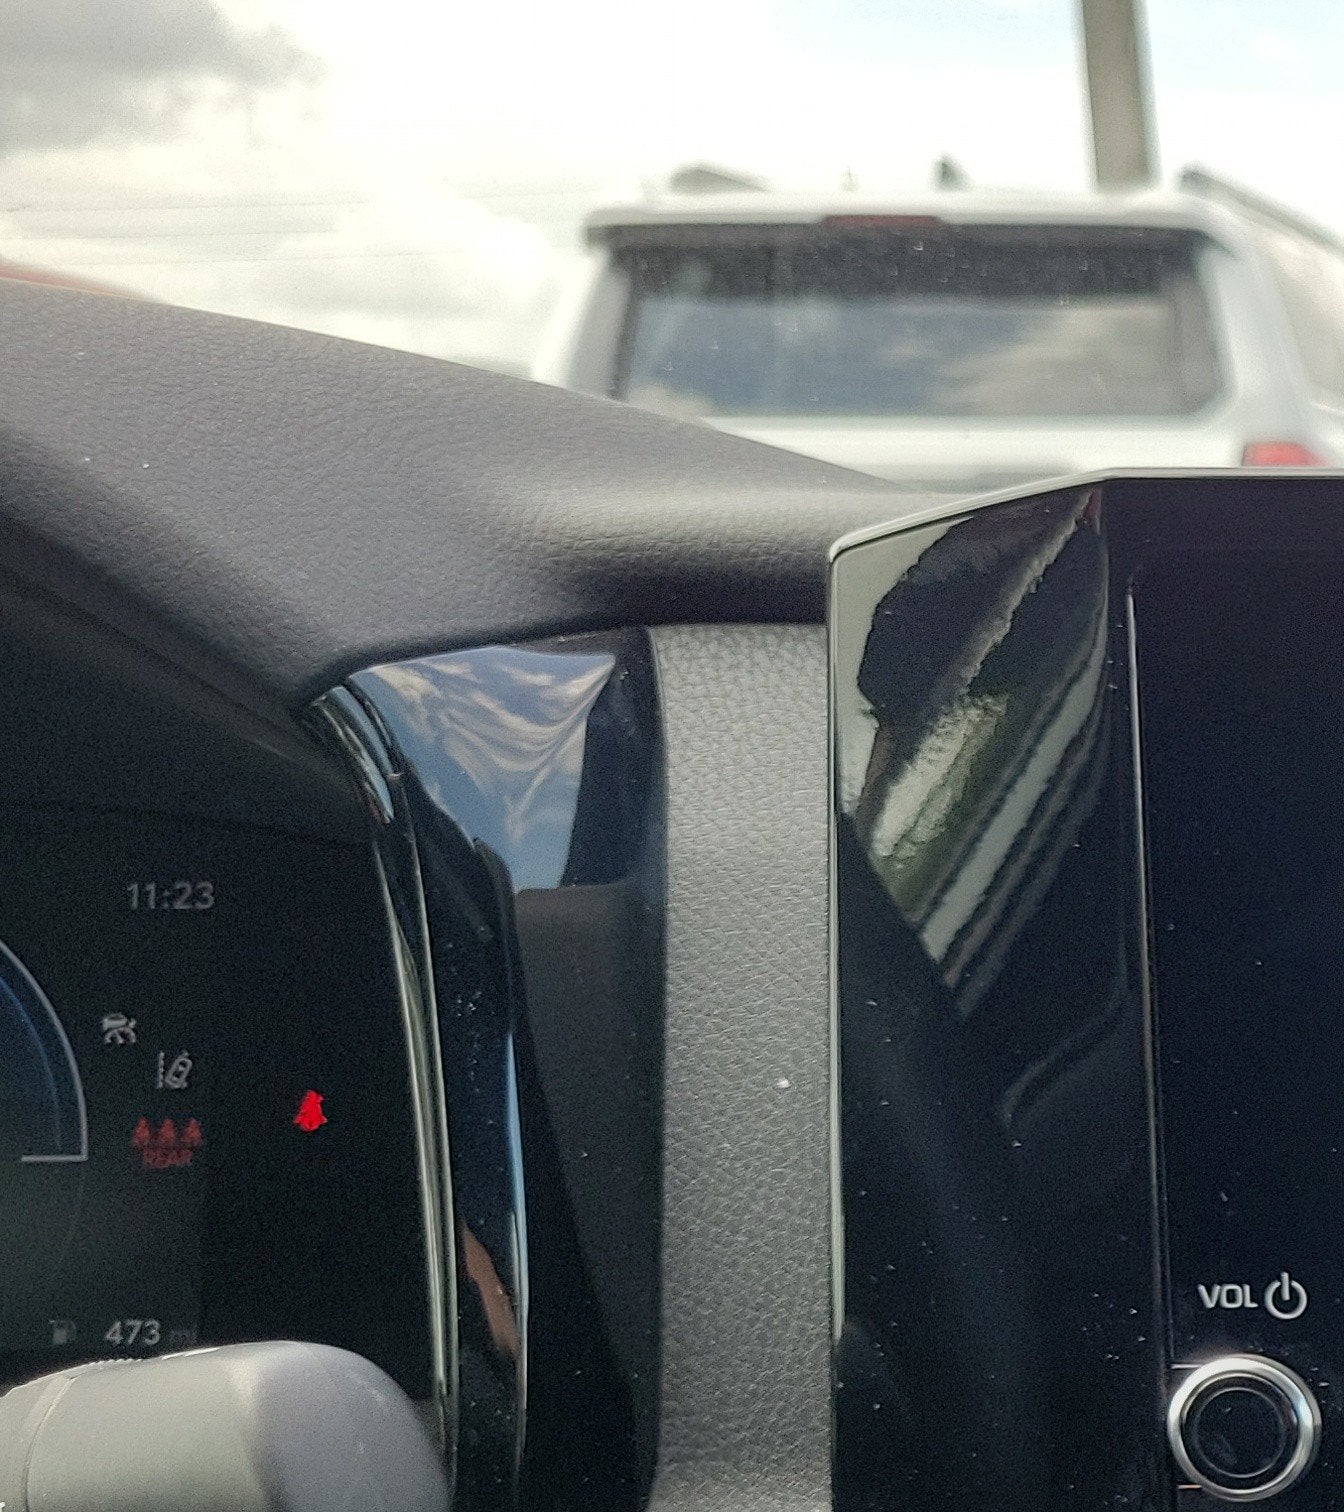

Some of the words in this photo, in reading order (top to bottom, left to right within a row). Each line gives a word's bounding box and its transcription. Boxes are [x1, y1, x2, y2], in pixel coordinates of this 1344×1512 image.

[127, 882, 214, 909] 11:23
[1198, 1284, 1258, 1308] VOL
[105, 1320, 160, 1345] 473
